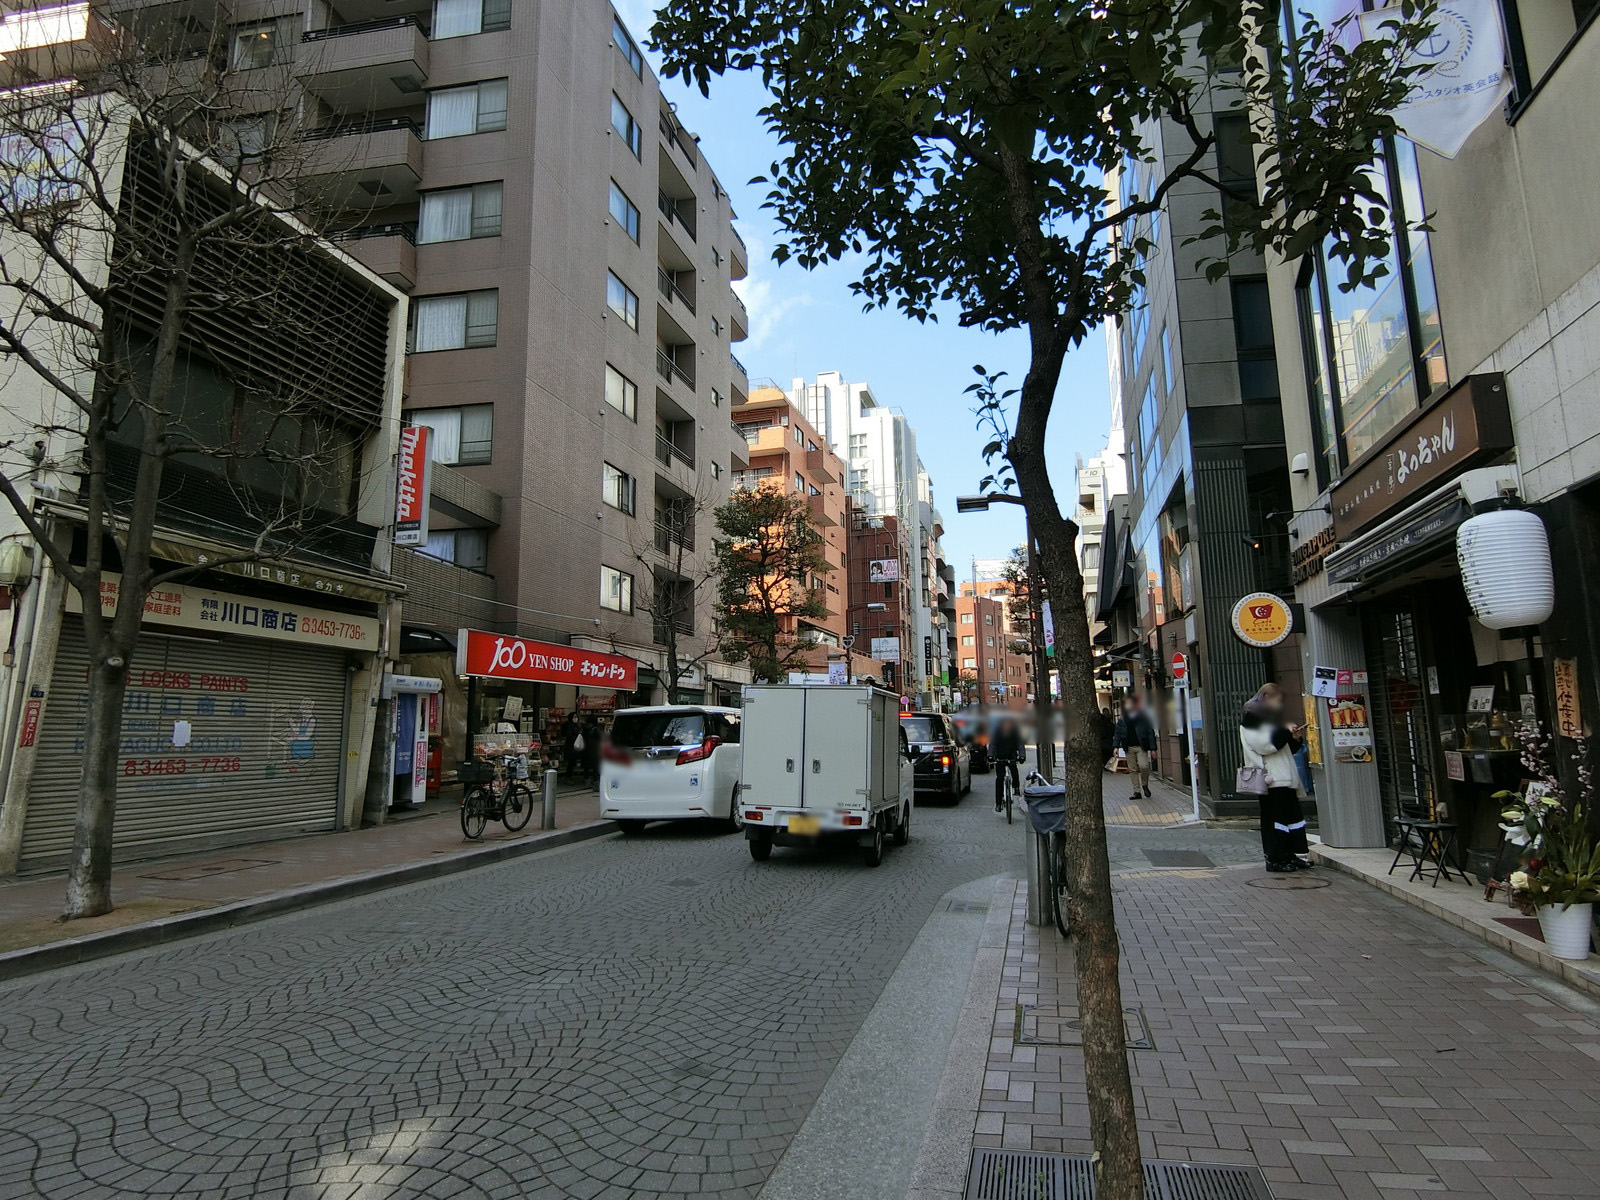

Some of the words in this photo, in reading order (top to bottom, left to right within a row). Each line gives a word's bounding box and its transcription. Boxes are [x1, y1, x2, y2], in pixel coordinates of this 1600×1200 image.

[1397, 409, 1455, 484] よっちゃん
[1290, 524, 1336, 567] SINGAPORE
[243, 562, 300, 585] 川口商店
[314, 579, 344, 593] 合カギ
[143, 602, 182, 616] 家庭塗料
[201, 598, 219, 610] 有限
[200, 610, 218, 622] 会社
[221, 601, 298, 633] 川口商店
[488, 637, 526, 673] 100
[529, 653, 549, 669] YEN
[550, 657, 574, 673] SHOP
[141, 671, 192, 689] LOCKS
[200, 674, 249, 691] PAINTS
